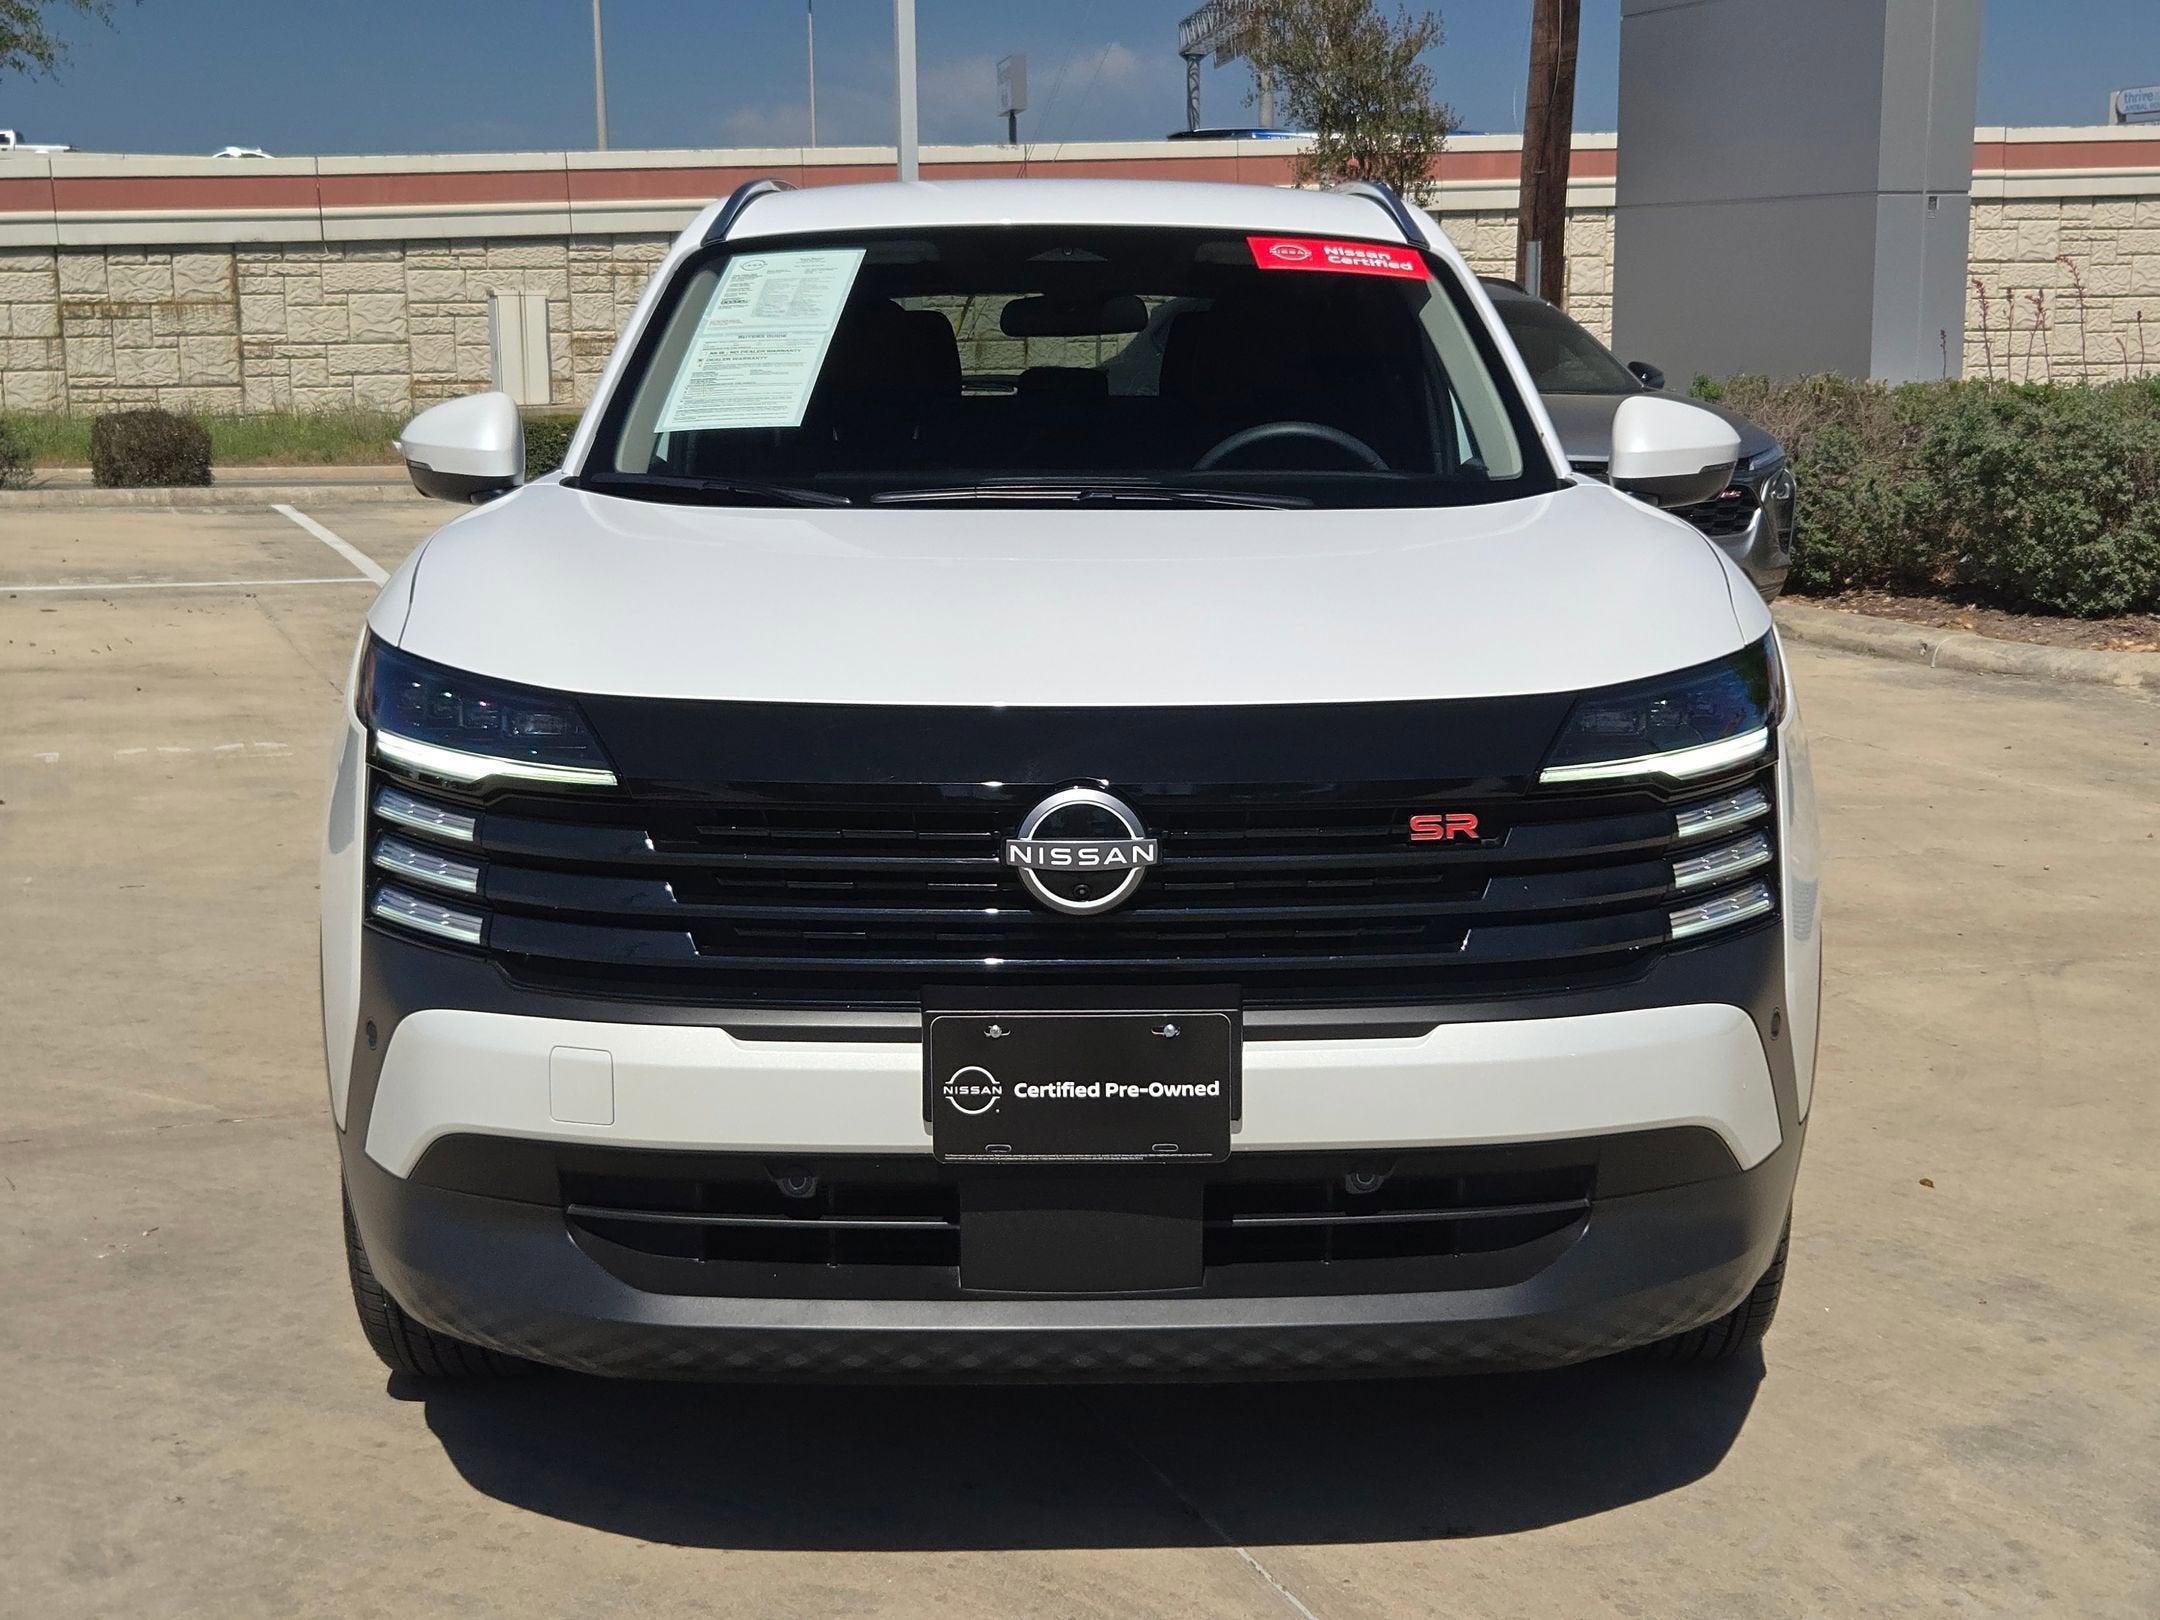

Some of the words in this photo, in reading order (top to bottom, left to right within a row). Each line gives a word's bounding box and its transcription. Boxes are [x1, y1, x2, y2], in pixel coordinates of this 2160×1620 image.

[2124, 89, 2154, 104] thrive
[1323, 245, 1391, 260] Nissan
[1327, 255, 1414, 271] Certified
[1410, 813, 1479, 841] SR
[1009, 844, 1154, 866] NISSAN
[943, 1085, 1003, 1095] NISSAN
[1014, 1081, 1100, 1099] Certified
[1105, 1080, 1220, 1098] Pre-Owned
